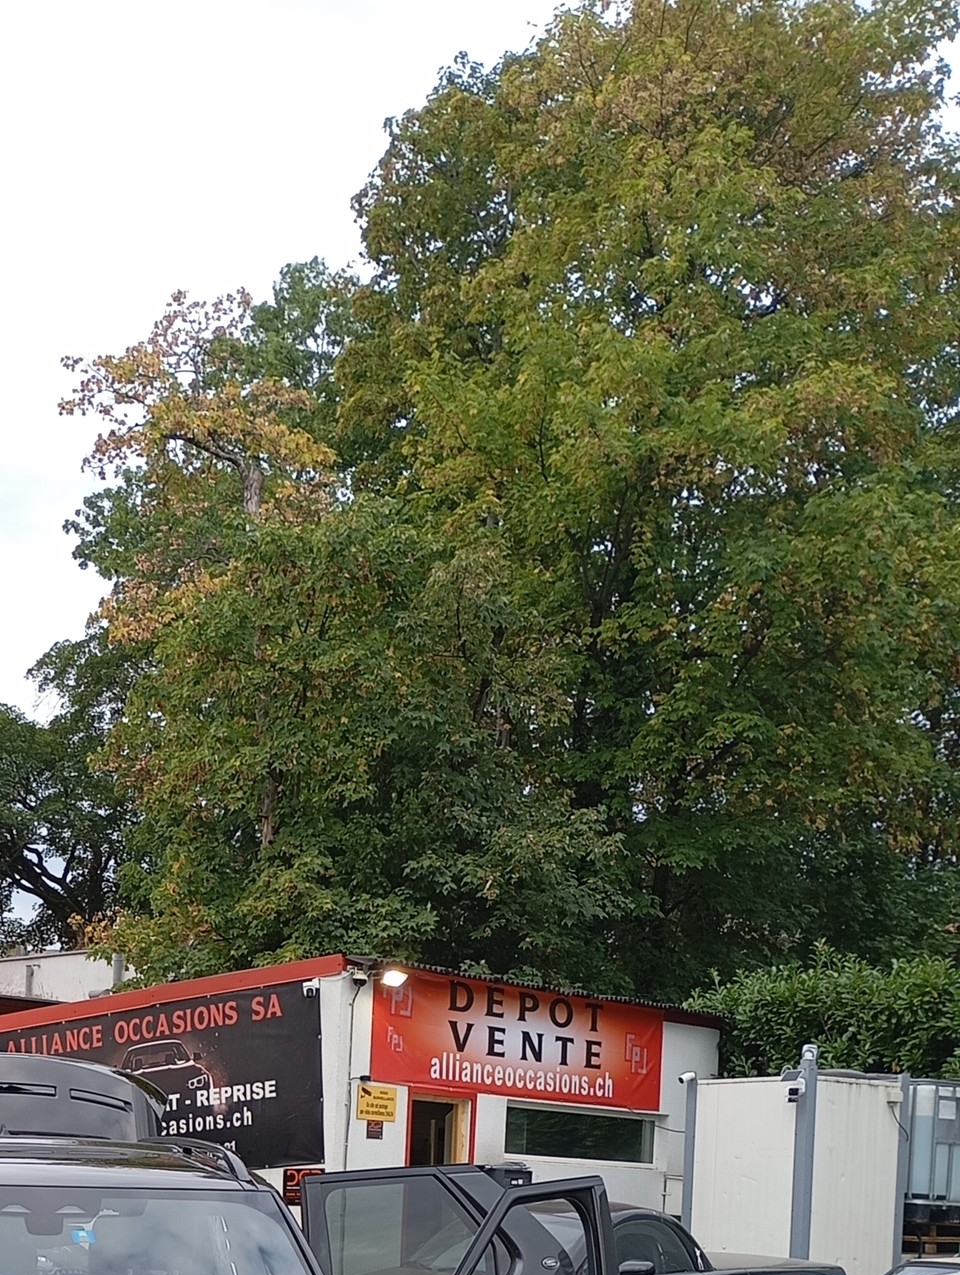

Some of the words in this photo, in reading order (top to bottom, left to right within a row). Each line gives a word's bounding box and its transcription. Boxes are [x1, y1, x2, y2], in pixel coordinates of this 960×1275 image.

[114, 1001, 238, 1044] OCCASIONS
[251, 994, 282, 1021] SA
[448, 980, 604, 1032] DEPOT
[448, 1020, 603, 1069] VENTE
[196, 1080, 276, 1107] REPRISE
[430, 1052, 613, 1098] allianceoccasions.ch
